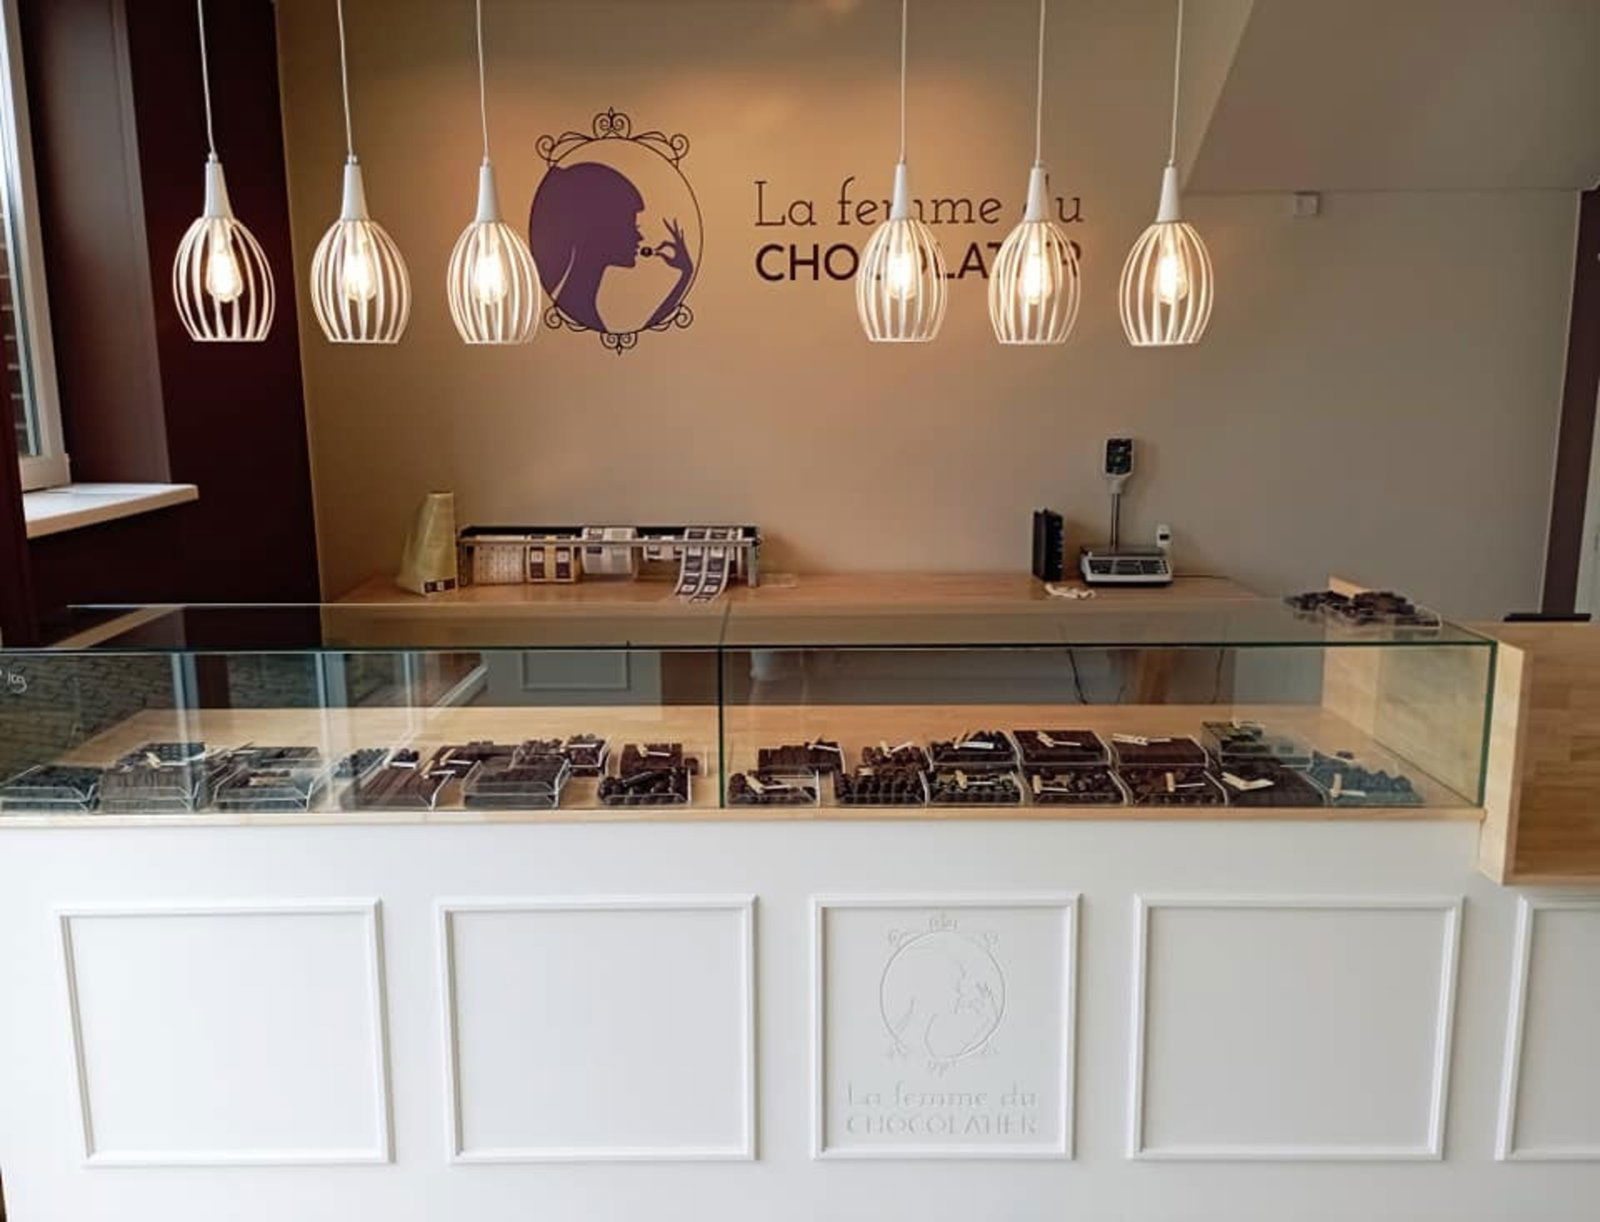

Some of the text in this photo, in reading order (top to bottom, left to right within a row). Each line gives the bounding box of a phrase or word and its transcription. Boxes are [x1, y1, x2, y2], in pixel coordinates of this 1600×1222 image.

[754, 180, 817, 226] La
[1021, 172, 1085, 223] u
[847, 1080, 1038, 1107] La femme du
[845, 1115, 1038, 1135] CHOCOLATIER
